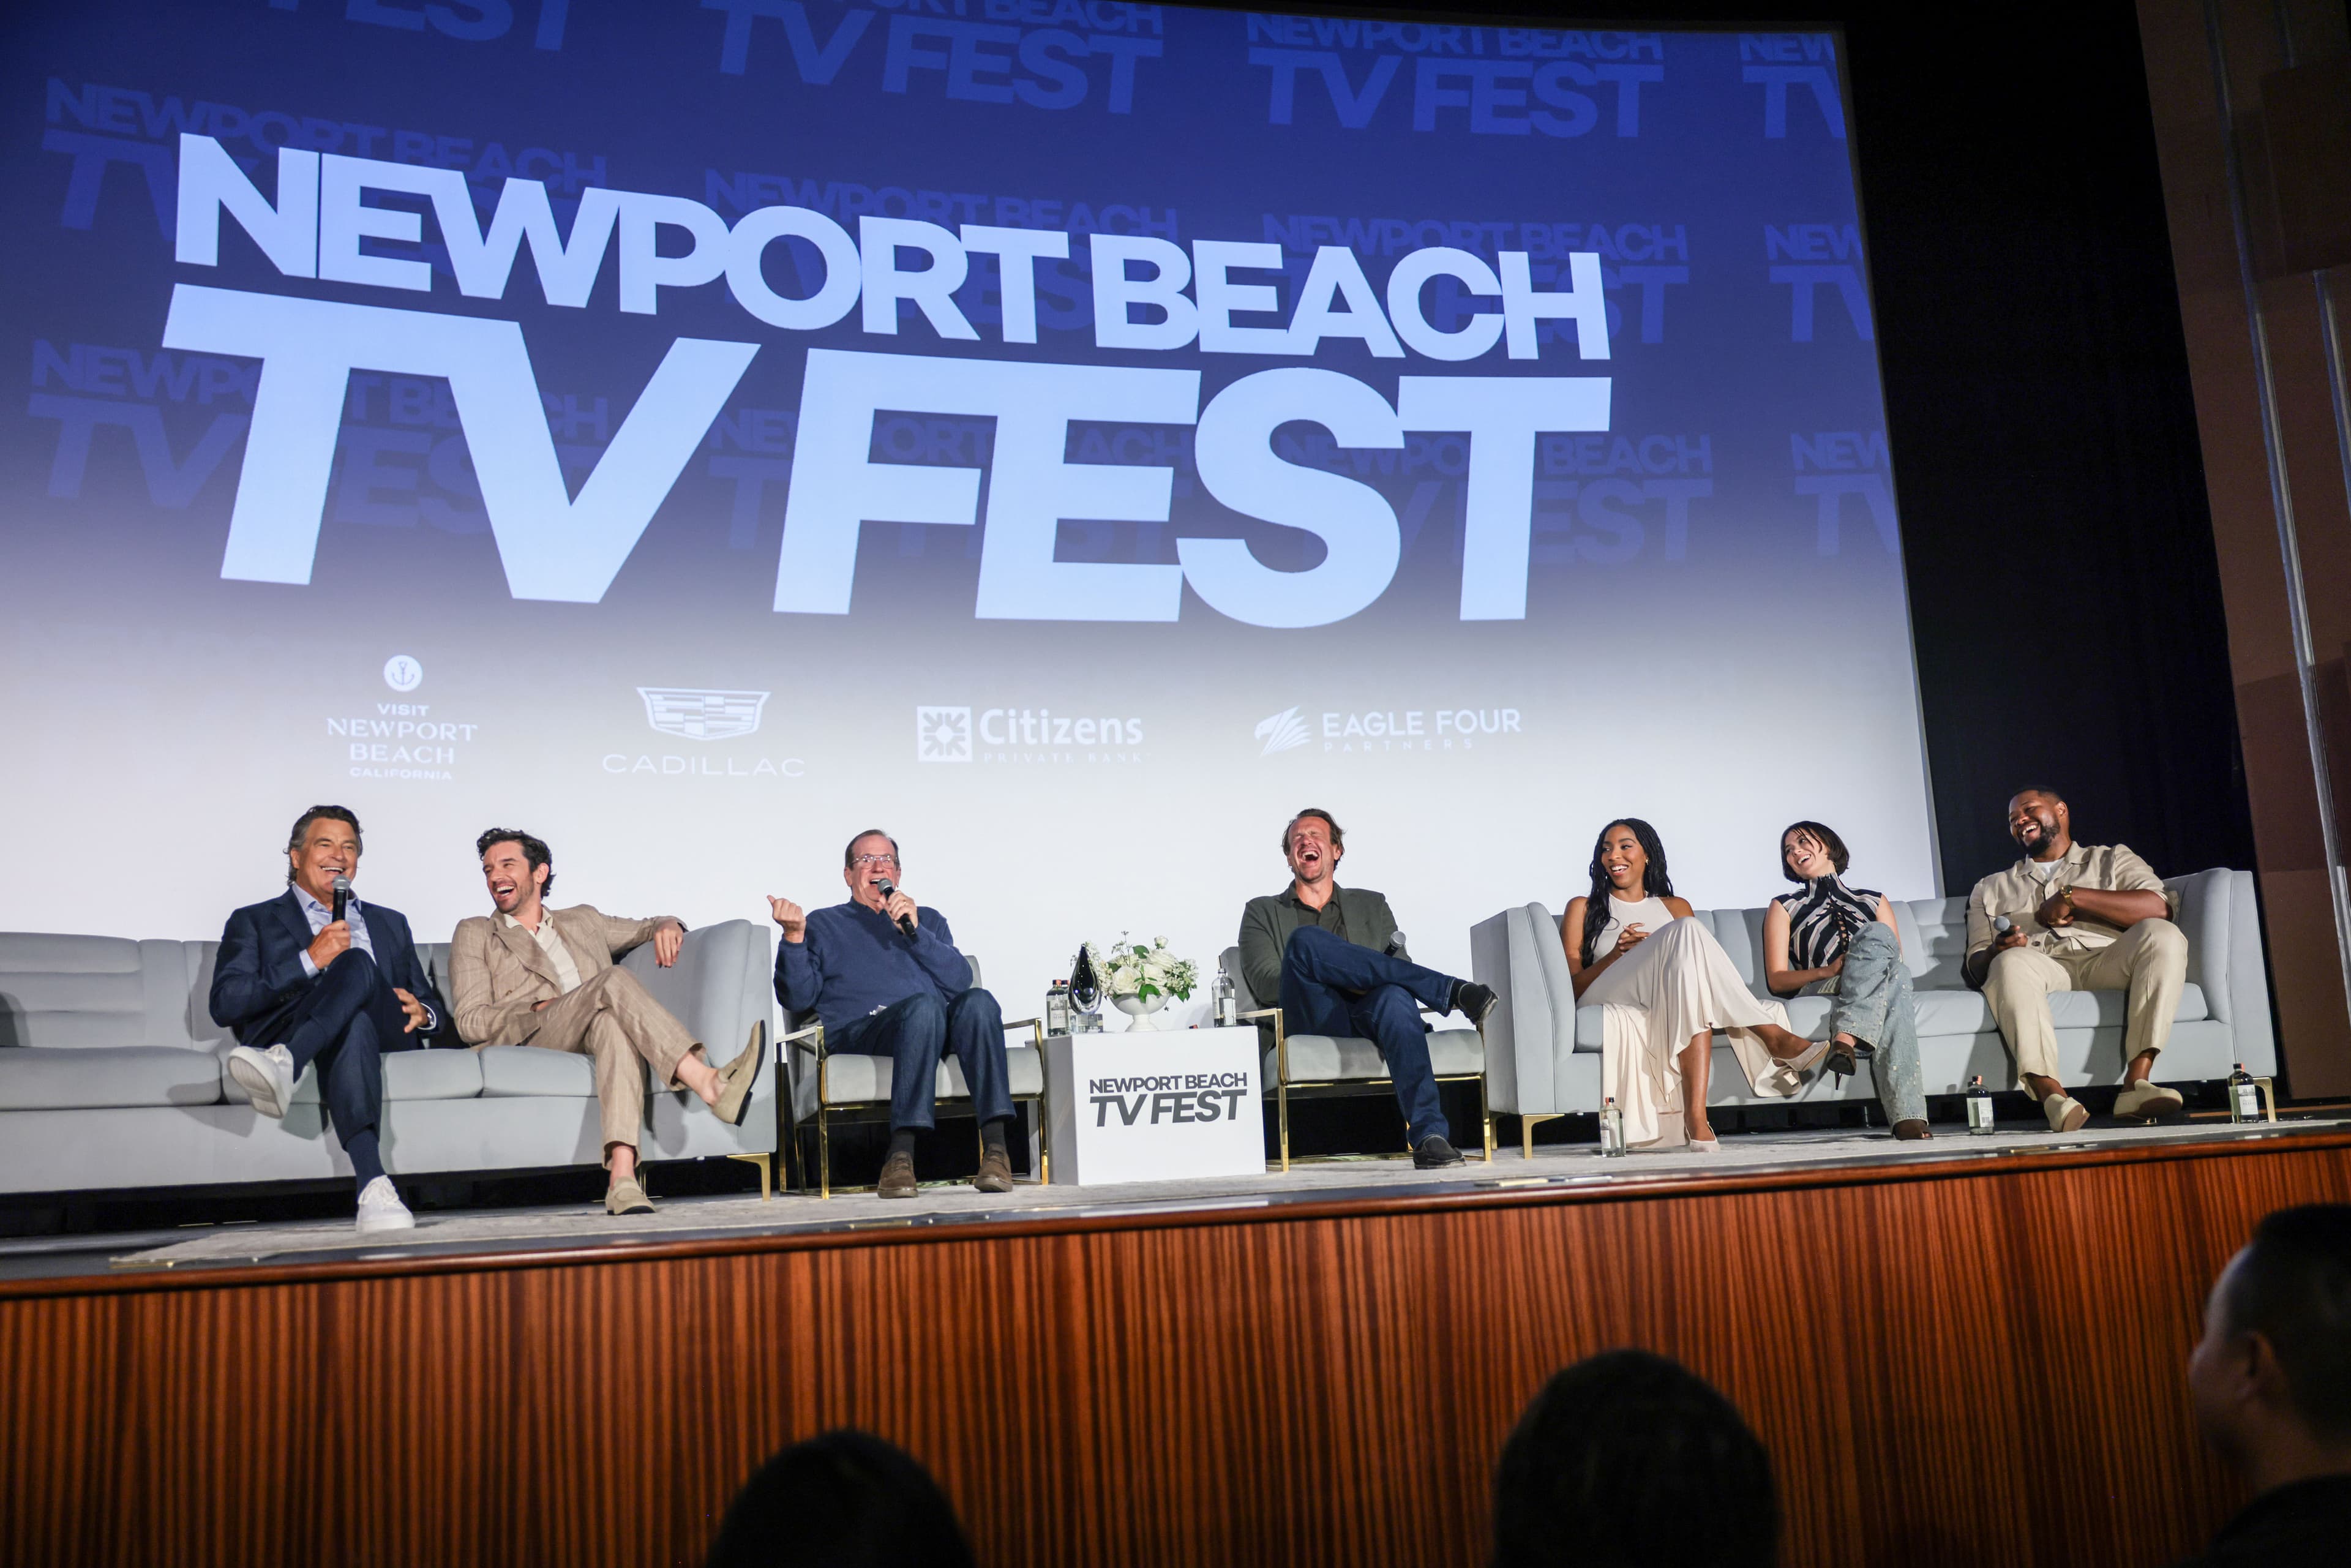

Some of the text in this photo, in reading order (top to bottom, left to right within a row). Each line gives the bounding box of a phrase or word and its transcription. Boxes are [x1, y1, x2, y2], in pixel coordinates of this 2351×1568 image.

[700, 0, 1162, 114] TV FEST
[1499, 28, 1663, 60] BEACH
[1248, 47, 1663, 138] TV FEST
[175, 132, 1070, 345] NEWPORT
[1089, 233, 1611, 361] BEACH
[1262, 212, 1689, 260] NEWPORT BEACH
[28, 393, 249, 509] TV
[162, 283, 1612, 628] TV FEST
[1542, 434, 1712, 475] BEACH
[377, 703, 429, 716] VISIT
[1323, 708, 1521, 737] EAGLE FOUR
[326, 717, 478, 741] NEWPORT
[980, 708, 1143, 745] Citizens
[350, 743, 454, 765] BEACH
[984, 752, 1074, 764] PRIVATE
[1324, 738, 1473, 752] PARTNERS
[349, 767, 452, 780] CALIFORNIA
[602, 754, 805, 778] CADILLAC
[1089, 1072, 1247, 1094] NEWPORT BEACH
[1090, 1089, 1247, 1127] TV FEST
